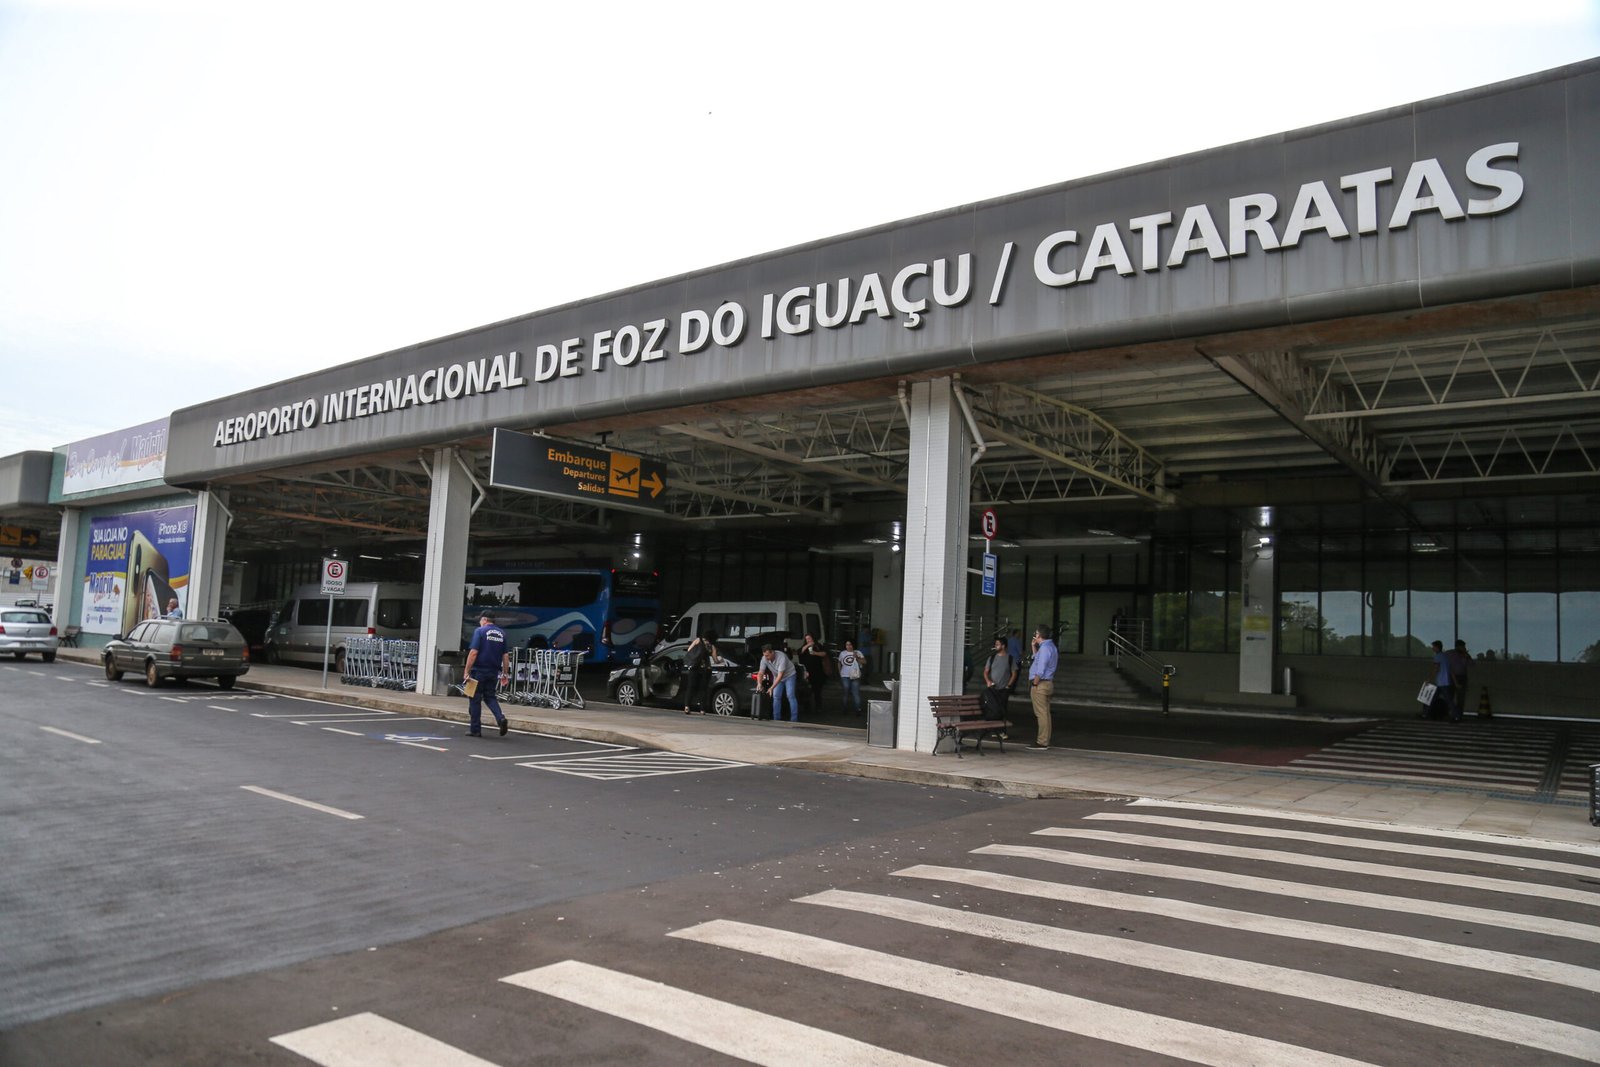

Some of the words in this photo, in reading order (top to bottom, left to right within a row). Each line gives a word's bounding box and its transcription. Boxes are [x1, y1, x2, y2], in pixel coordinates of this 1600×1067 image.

[213, 399, 320, 447] AEROPORTO
[321, 351, 527, 424] INTERNACIONAL
[534, 337, 584, 384] DE
[591, 318, 670, 372] FOZ
[679, 301, 748, 355] DO
[761, 252, 974, 339] IGUAÇU
[989, 241, 1016, 305] /
[1033, 141, 1525, 289] CATARATAS
[547, 448, 607, 470] Embarque
[563, 467, 606, 482] Departures
[578, 482, 605, 494] Salidas
[93, 529, 104, 543] SUA
[104, 528, 118, 542] LOJA
[117, 527, 128, 542] NO
[158, 523, 177, 536] iPhone
[89, 572, 114, 594] Madrid
